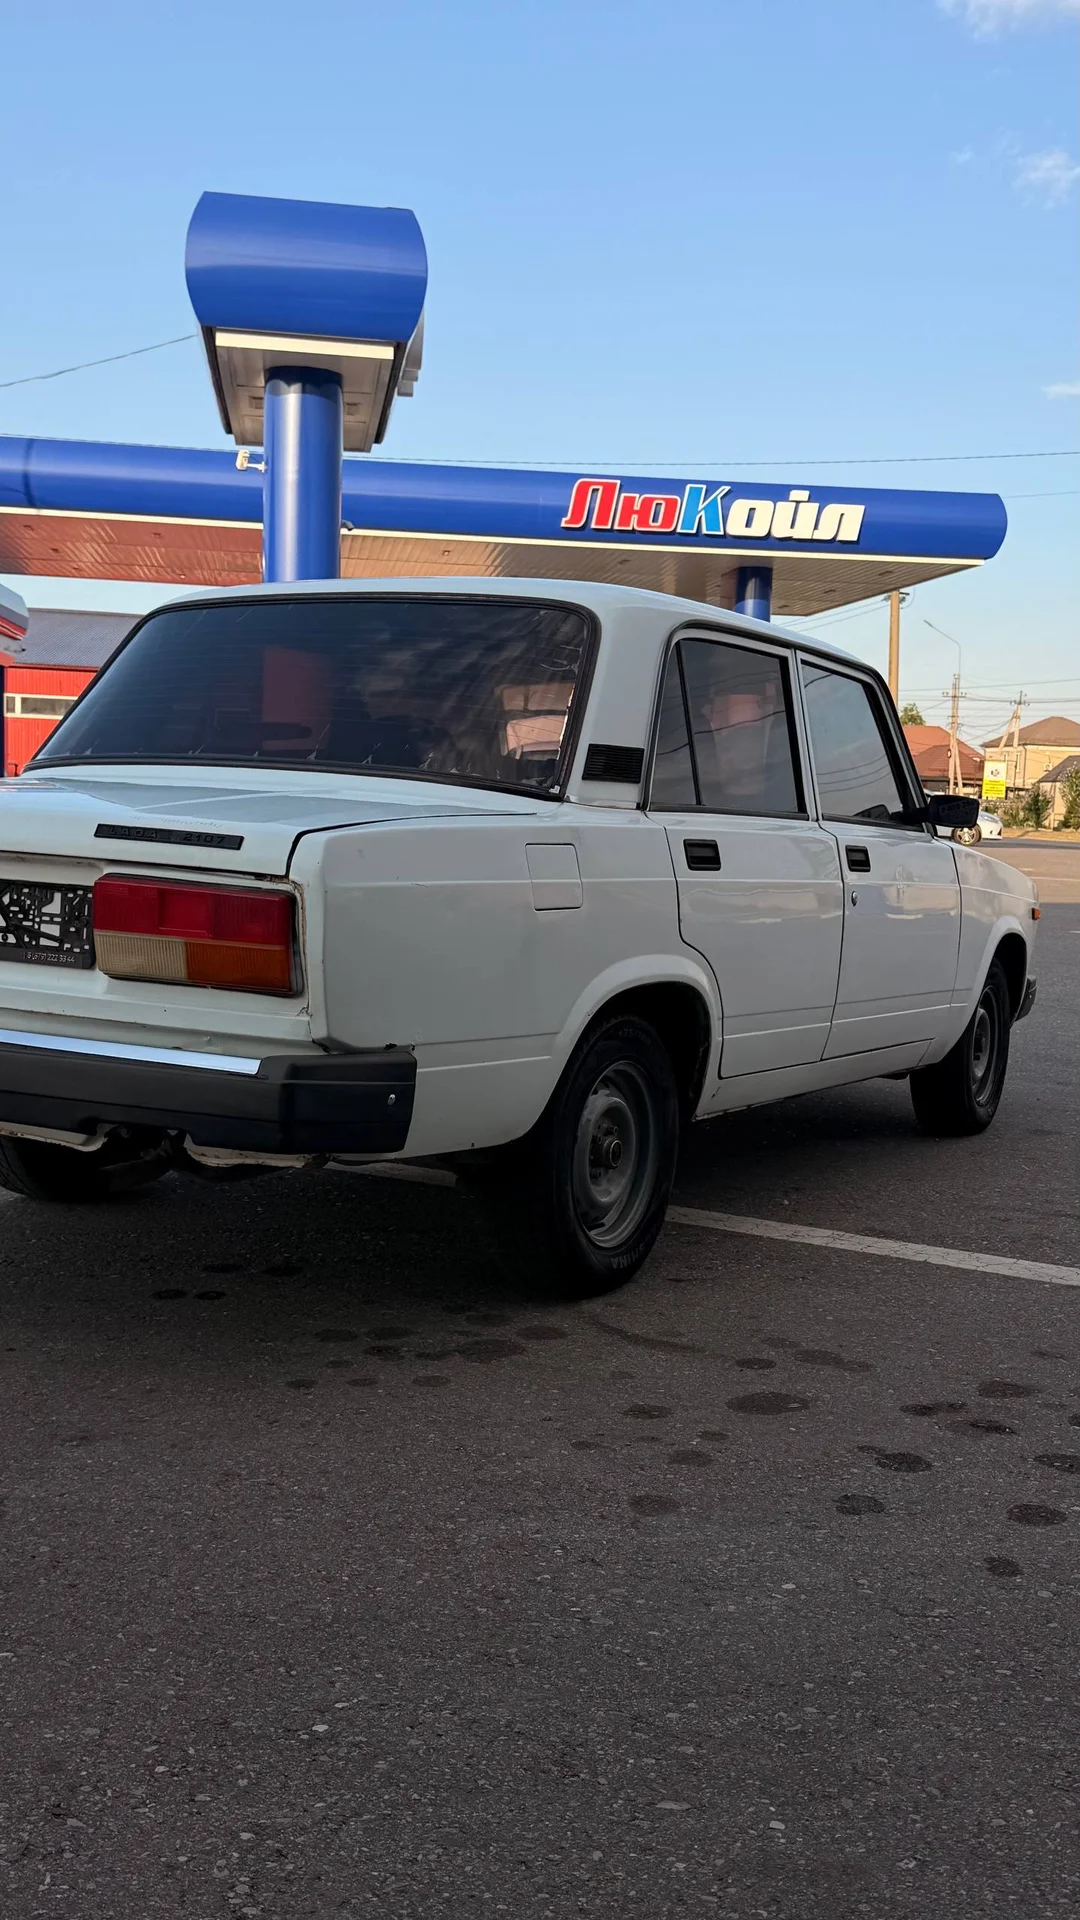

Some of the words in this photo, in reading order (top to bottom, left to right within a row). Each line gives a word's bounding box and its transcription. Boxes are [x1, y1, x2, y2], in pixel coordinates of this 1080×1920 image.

[560, 478, 866, 541] ЛюКойл
[109, 826, 158, 839] LADA
[183, 833, 227, 845] 2107
